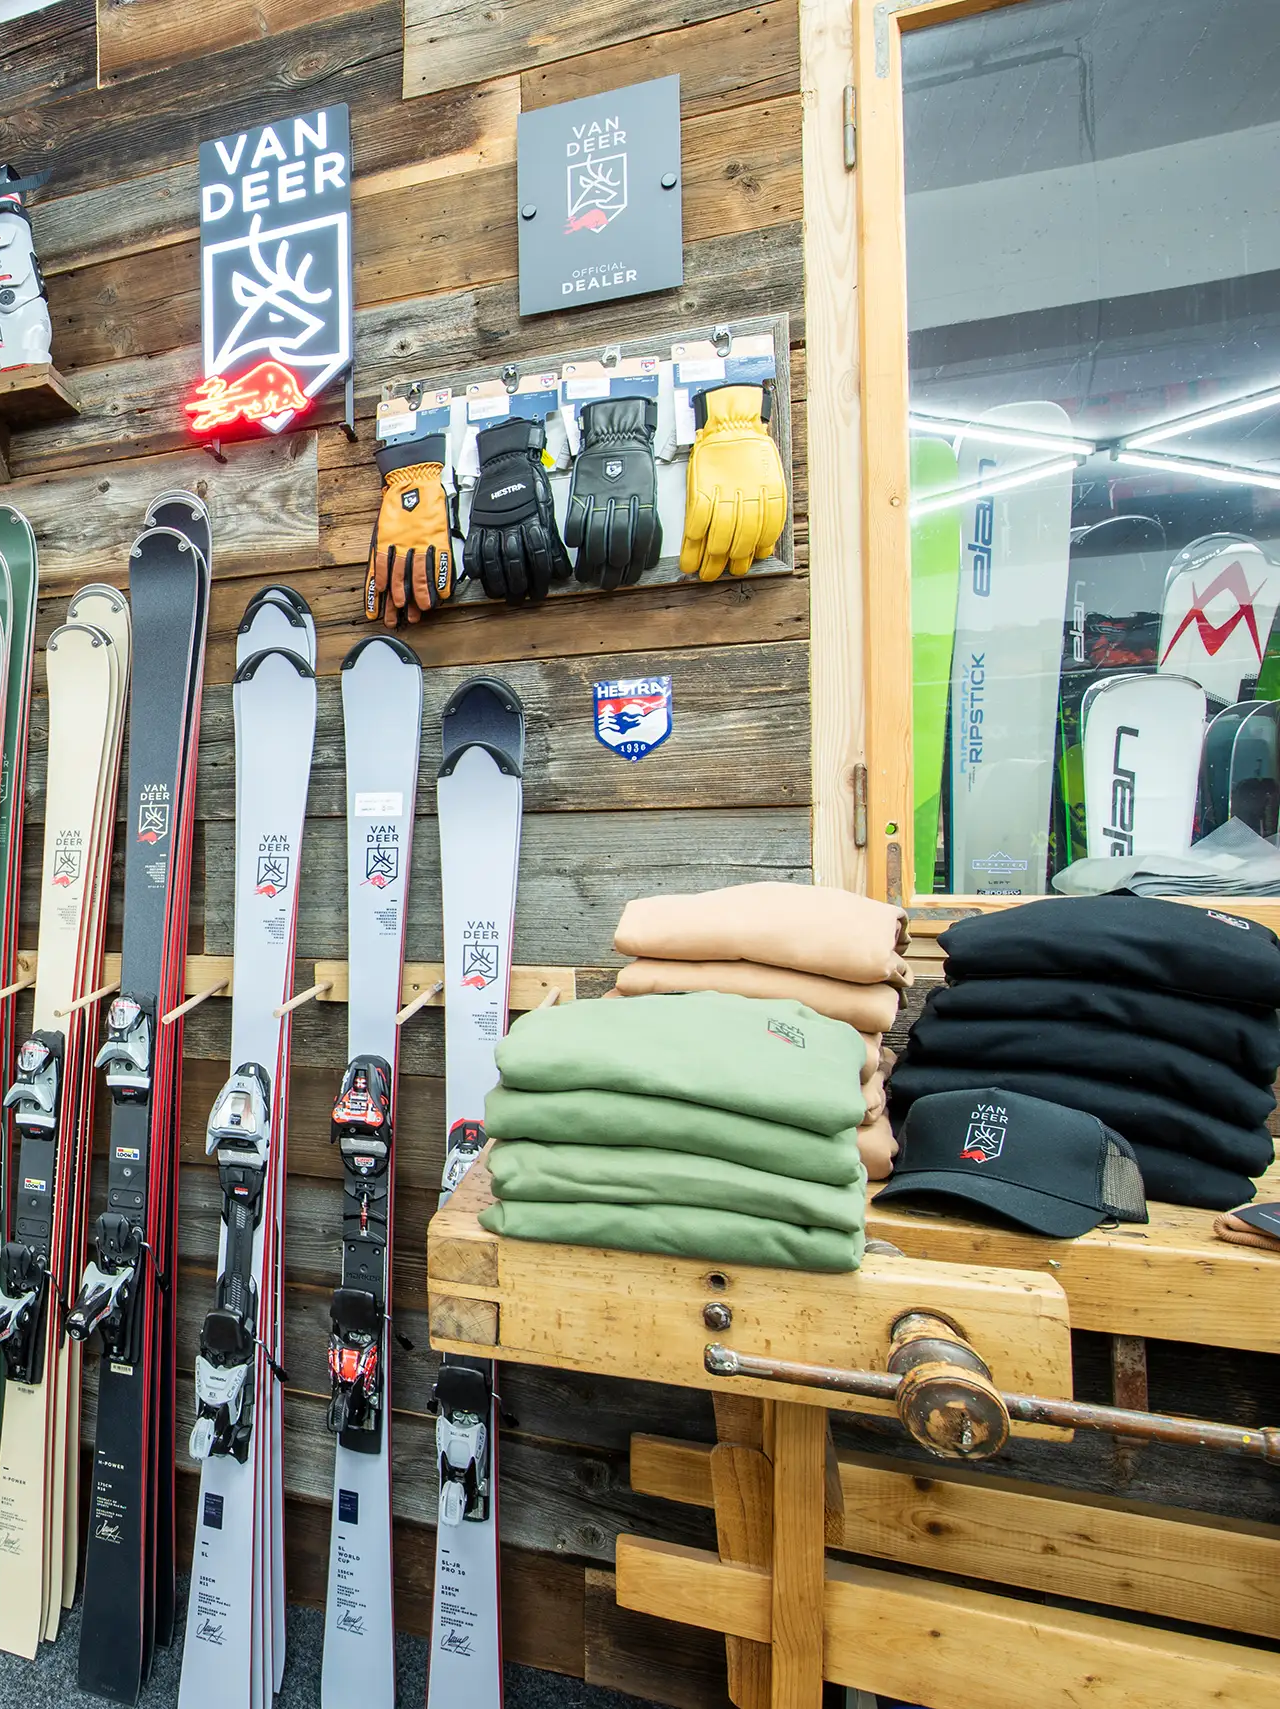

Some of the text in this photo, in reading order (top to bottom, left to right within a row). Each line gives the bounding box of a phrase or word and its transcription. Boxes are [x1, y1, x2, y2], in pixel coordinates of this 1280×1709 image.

[572, 116, 619, 140] VAN
[214, 111, 327, 175] VAN
[567, 130, 626, 157] DEER
[202, 151, 346, 223] DEER
[572, 262, 626, 278] OFFICIAL
[562, 269, 637, 294] DEALER
[490, 483, 526, 500] HESTRA
[968, 459, 997, 598] elan
[438, 552, 448, 590] HESTRA
[367, 579, 375, 612] HESTRA
[1069, 581, 1086, 662] elan
[597, 682, 667, 699] HESTRA
[969, 653, 985, 764] RIPSTICK
[620, 743, 646, 753] 1936
[144, 784, 167, 793] VAN
[1103, 725, 1139, 857] elan
[140, 792, 170, 801] DEER
[370, 825, 396, 833] VAN
[56, 838, 82, 846] DEER
[366, 834, 399, 842] DEER
[259, 843, 290, 851] DEER
[467, 920, 495, 930] VAN
[463, 930, 499, 939] DEER
[977, 1104, 1006, 1115] VAN
[971, 1111, 1009, 1124] DEER
[98, 1459, 124, 1470] H-POWER
[2, 1475, 26, 1485] H-POWER
[338, 1551, 360, 1561] WORLD
[441, 1559, 460, 1568] SL-JR
[441, 1566, 455, 1574] PRO
